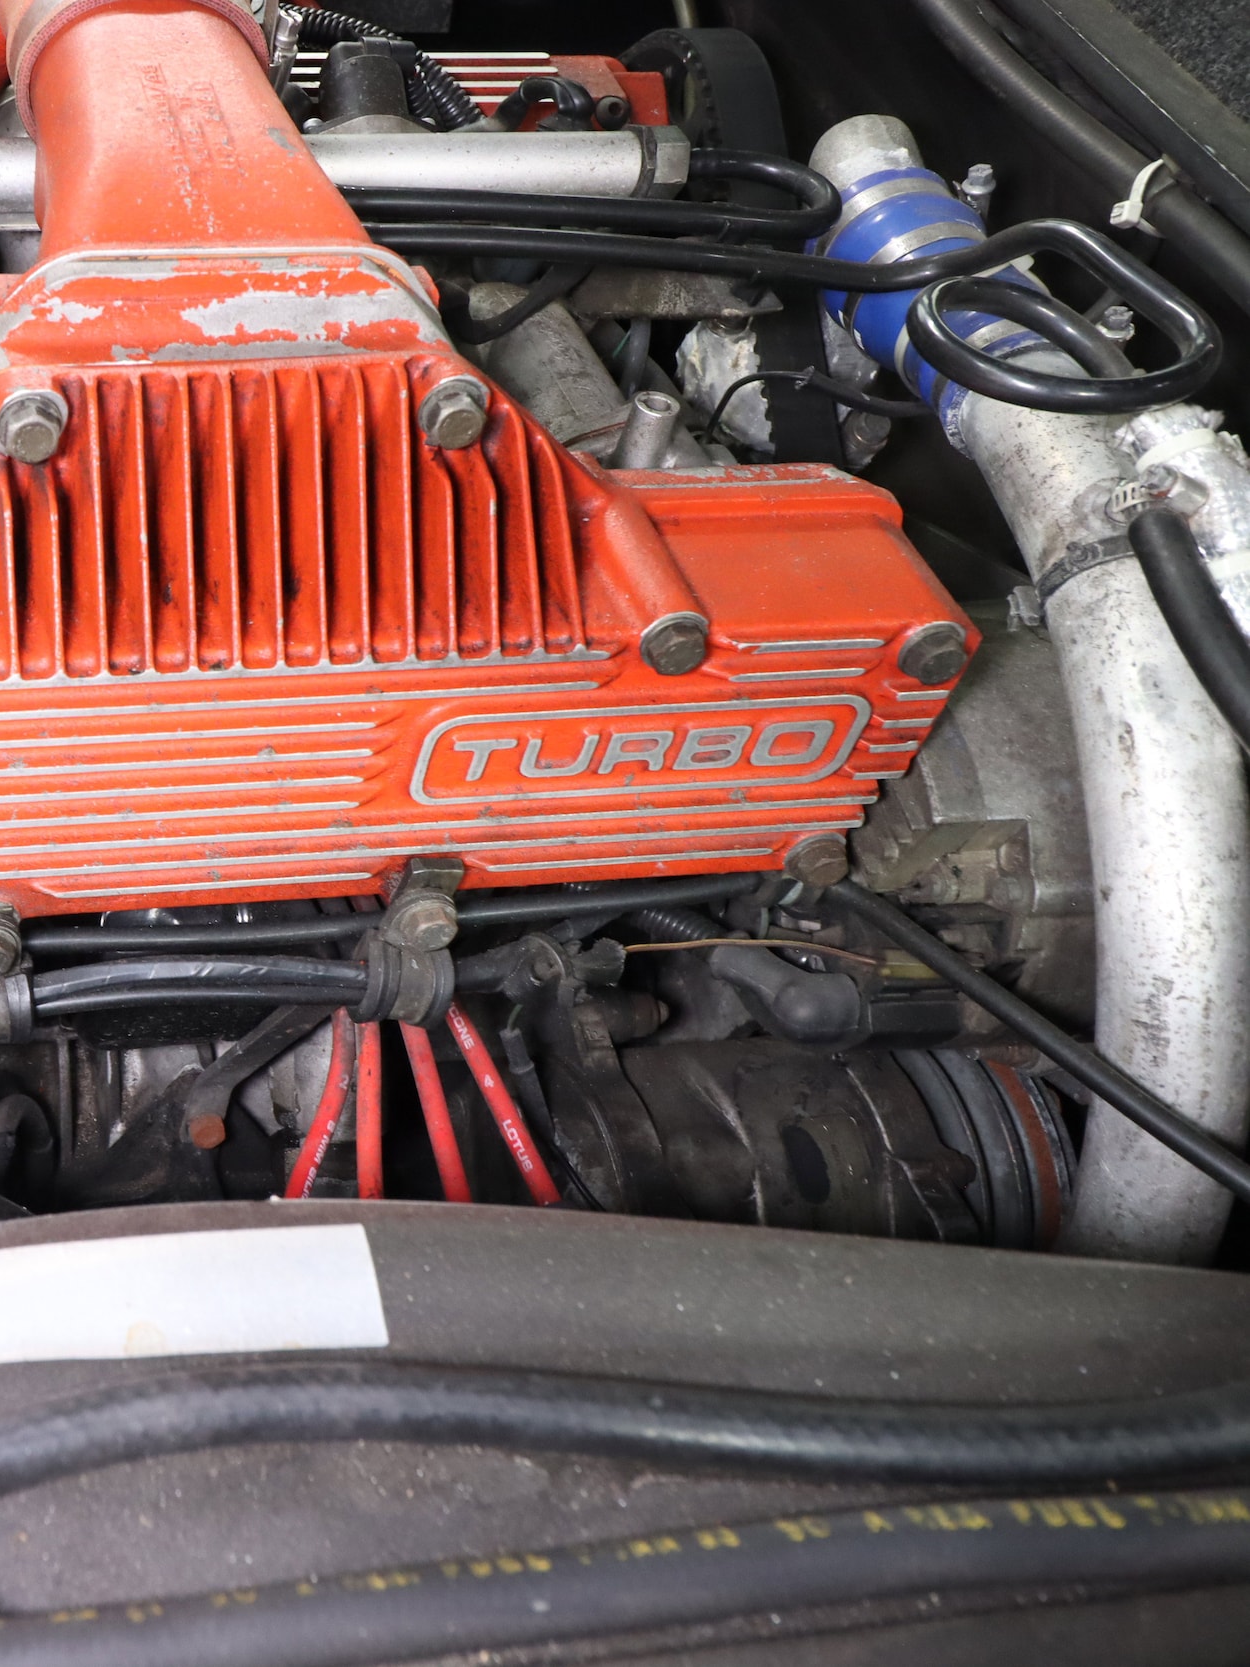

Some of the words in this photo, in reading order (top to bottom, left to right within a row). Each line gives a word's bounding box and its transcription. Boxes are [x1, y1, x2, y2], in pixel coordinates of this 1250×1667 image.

[452, 719, 836, 782] TURBO
[449, 1002, 475, 1050] CONE
[483, 1073, 495, 1088] 4
[501, 1118, 534, 1173] LOTUS
